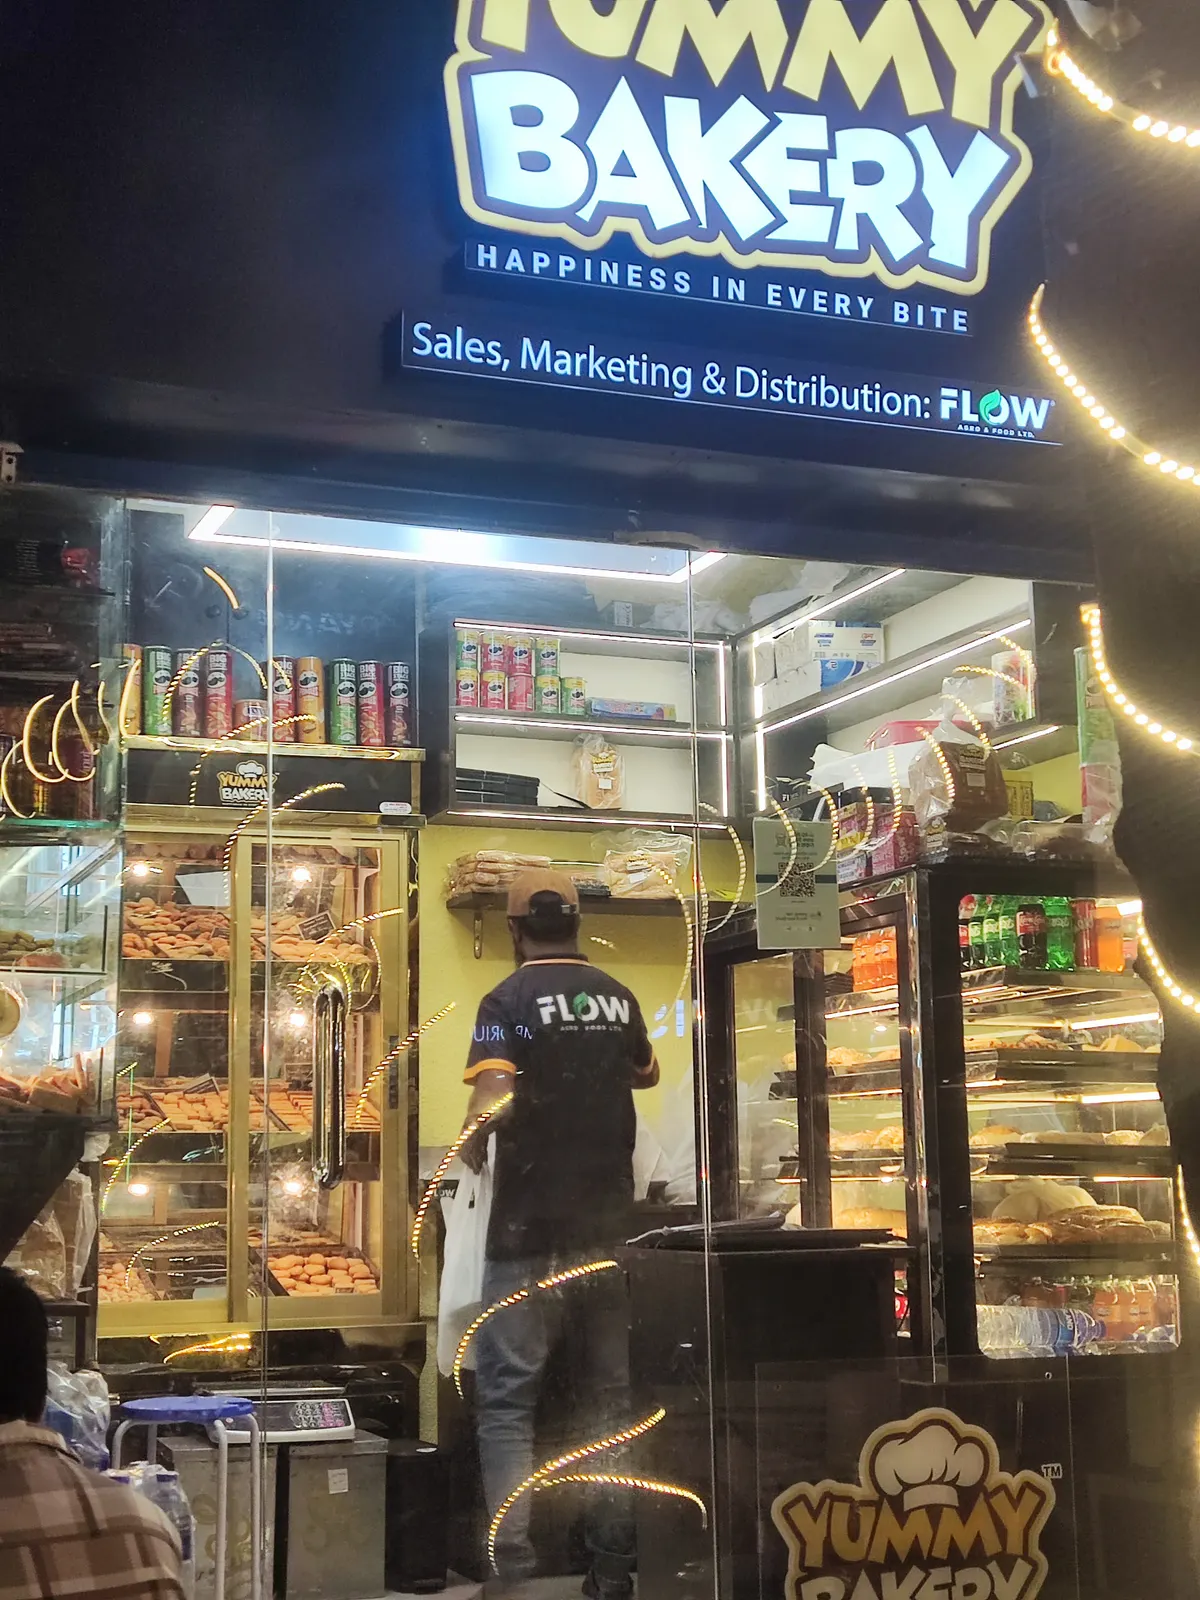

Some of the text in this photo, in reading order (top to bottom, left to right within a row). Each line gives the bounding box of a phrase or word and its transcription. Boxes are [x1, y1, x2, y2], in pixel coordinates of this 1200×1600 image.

[471, 70, 1011, 269] BAKERY
[477, 243, 968, 332] HAPPINESS IN EVERY BITE
[412, 322, 510, 372] Sales,
[520, 337, 692, 398] Marketing
[702, 362, 726, 395] &
[736, 366, 930, 419] Distribution:
[992, 428, 1015, 436] FOOD
[360, 664, 375, 673] BIG
[393, 665, 408, 674] BIG
[536, 992, 630, 1025] FLOW
[1042, 1464, 1061, 1479] TM
[788, 1486, 1039, 1568] YUMMY
